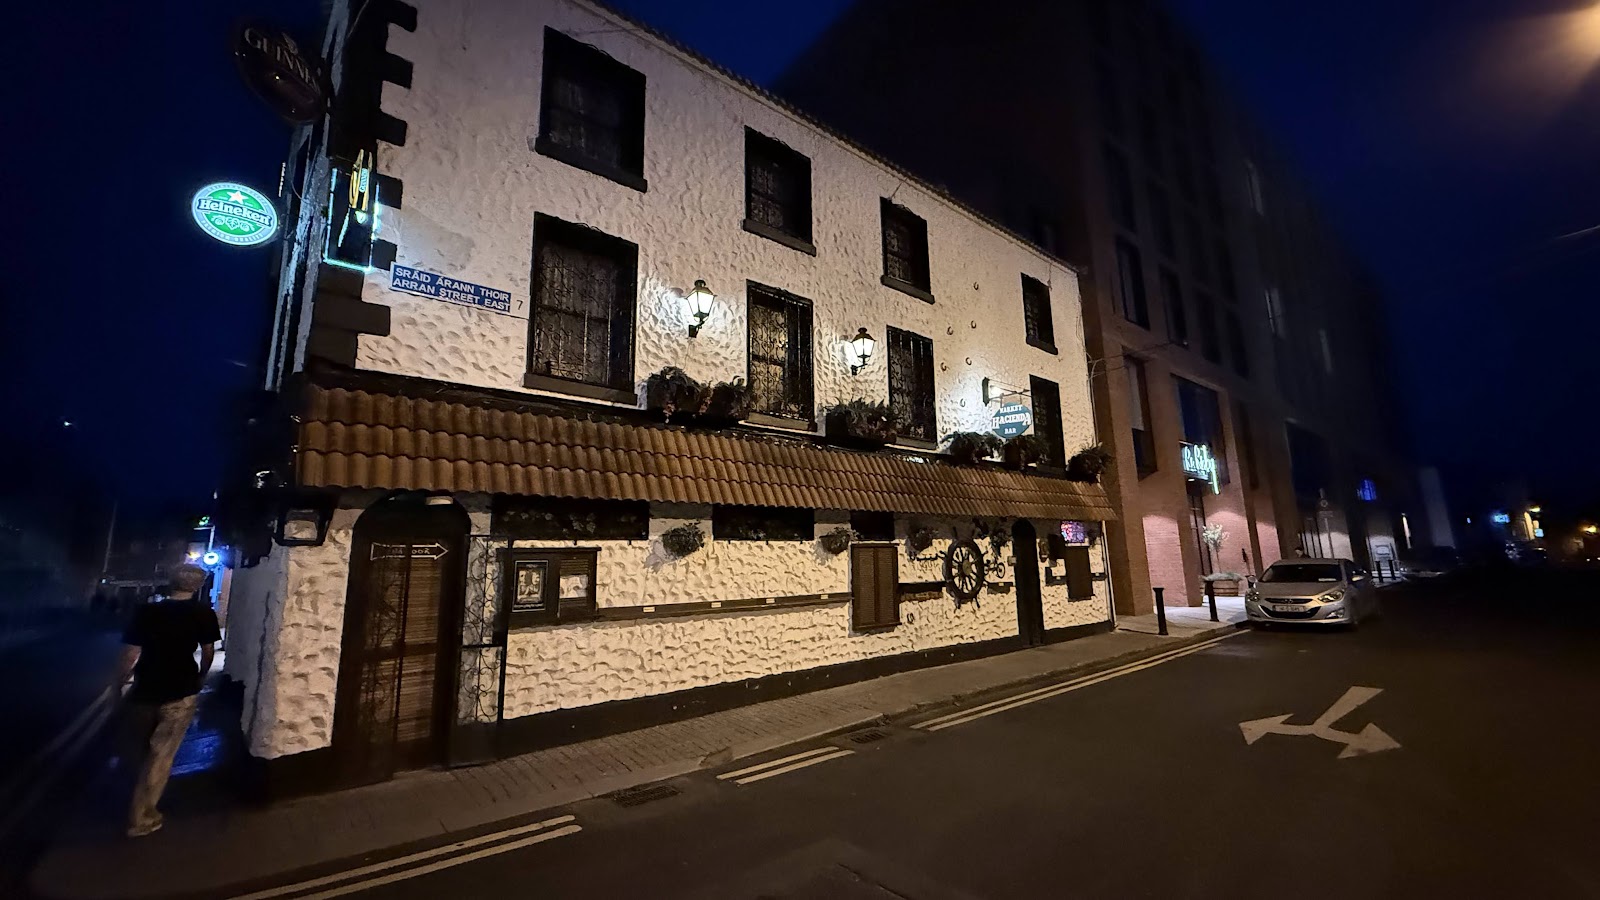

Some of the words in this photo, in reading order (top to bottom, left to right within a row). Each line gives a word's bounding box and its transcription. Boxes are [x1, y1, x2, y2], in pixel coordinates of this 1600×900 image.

[199, 199, 271, 225] Heineken
[393, 278, 435, 294] ARRAN
[439, 288, 480, 304] STREET
[484, 298, 510, 311] EAST
[395, 267, 431, 283] SRÁID
[436, 275, 475, 294] ÁRANN
[480, 288, 510, 302] THOIR
[516, 300, 523, 310] 7
[1000, 404, 1023, 413] MARKET
[992, 412, 1032, 429] HACIENDA
